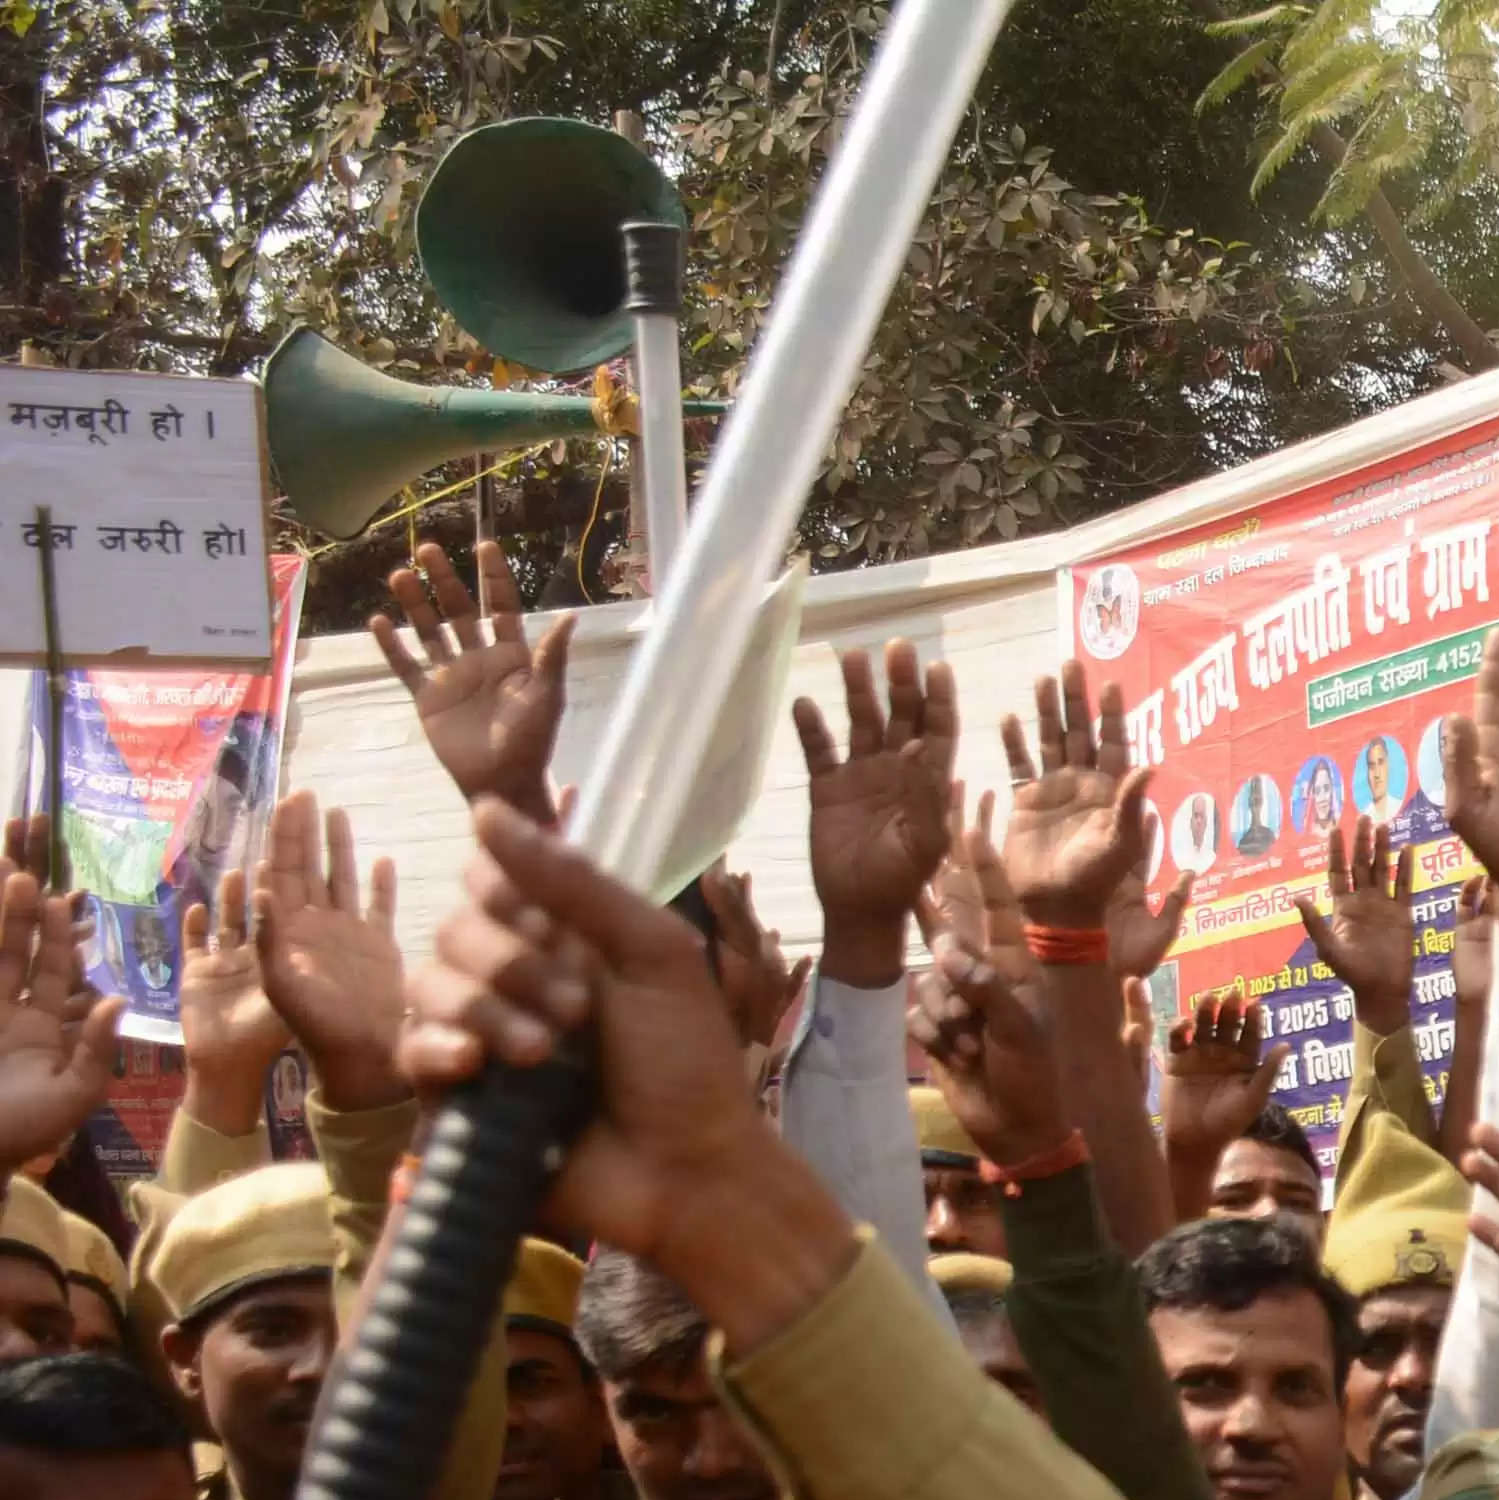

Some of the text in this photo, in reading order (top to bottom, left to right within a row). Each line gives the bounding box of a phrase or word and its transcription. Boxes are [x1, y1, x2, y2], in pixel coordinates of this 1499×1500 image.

[8, 399, 130, 446] मज़बूरी
[150, 403, 184, 441] हो
[1203, 564, 1225, 586] दल
[1170, 631, 1239, 744] राज्य
[1243, 551, 1352, 690] दलपति
[1359, 518, 1415, 635] एवं
[1420, 519, 1491, 622] ग्राम
[1311, 677, 1374, 714] पंजीयन
[1379, 655, 1429, 697] संख्या
[1421, 839, 1465, 884] पूर्ति
[1423, 927, 1457, 956] बिहा
[1249, 973, 1277, 998] 2025
[1277, 965, 1294, 988] से
[1295, 967, 1309, 987] 21
[1278, 1001, 1329, 1040] 2025
[1332, 987, 1356, 1021] को
[1303, 1038, 1355, 1088] विशा
